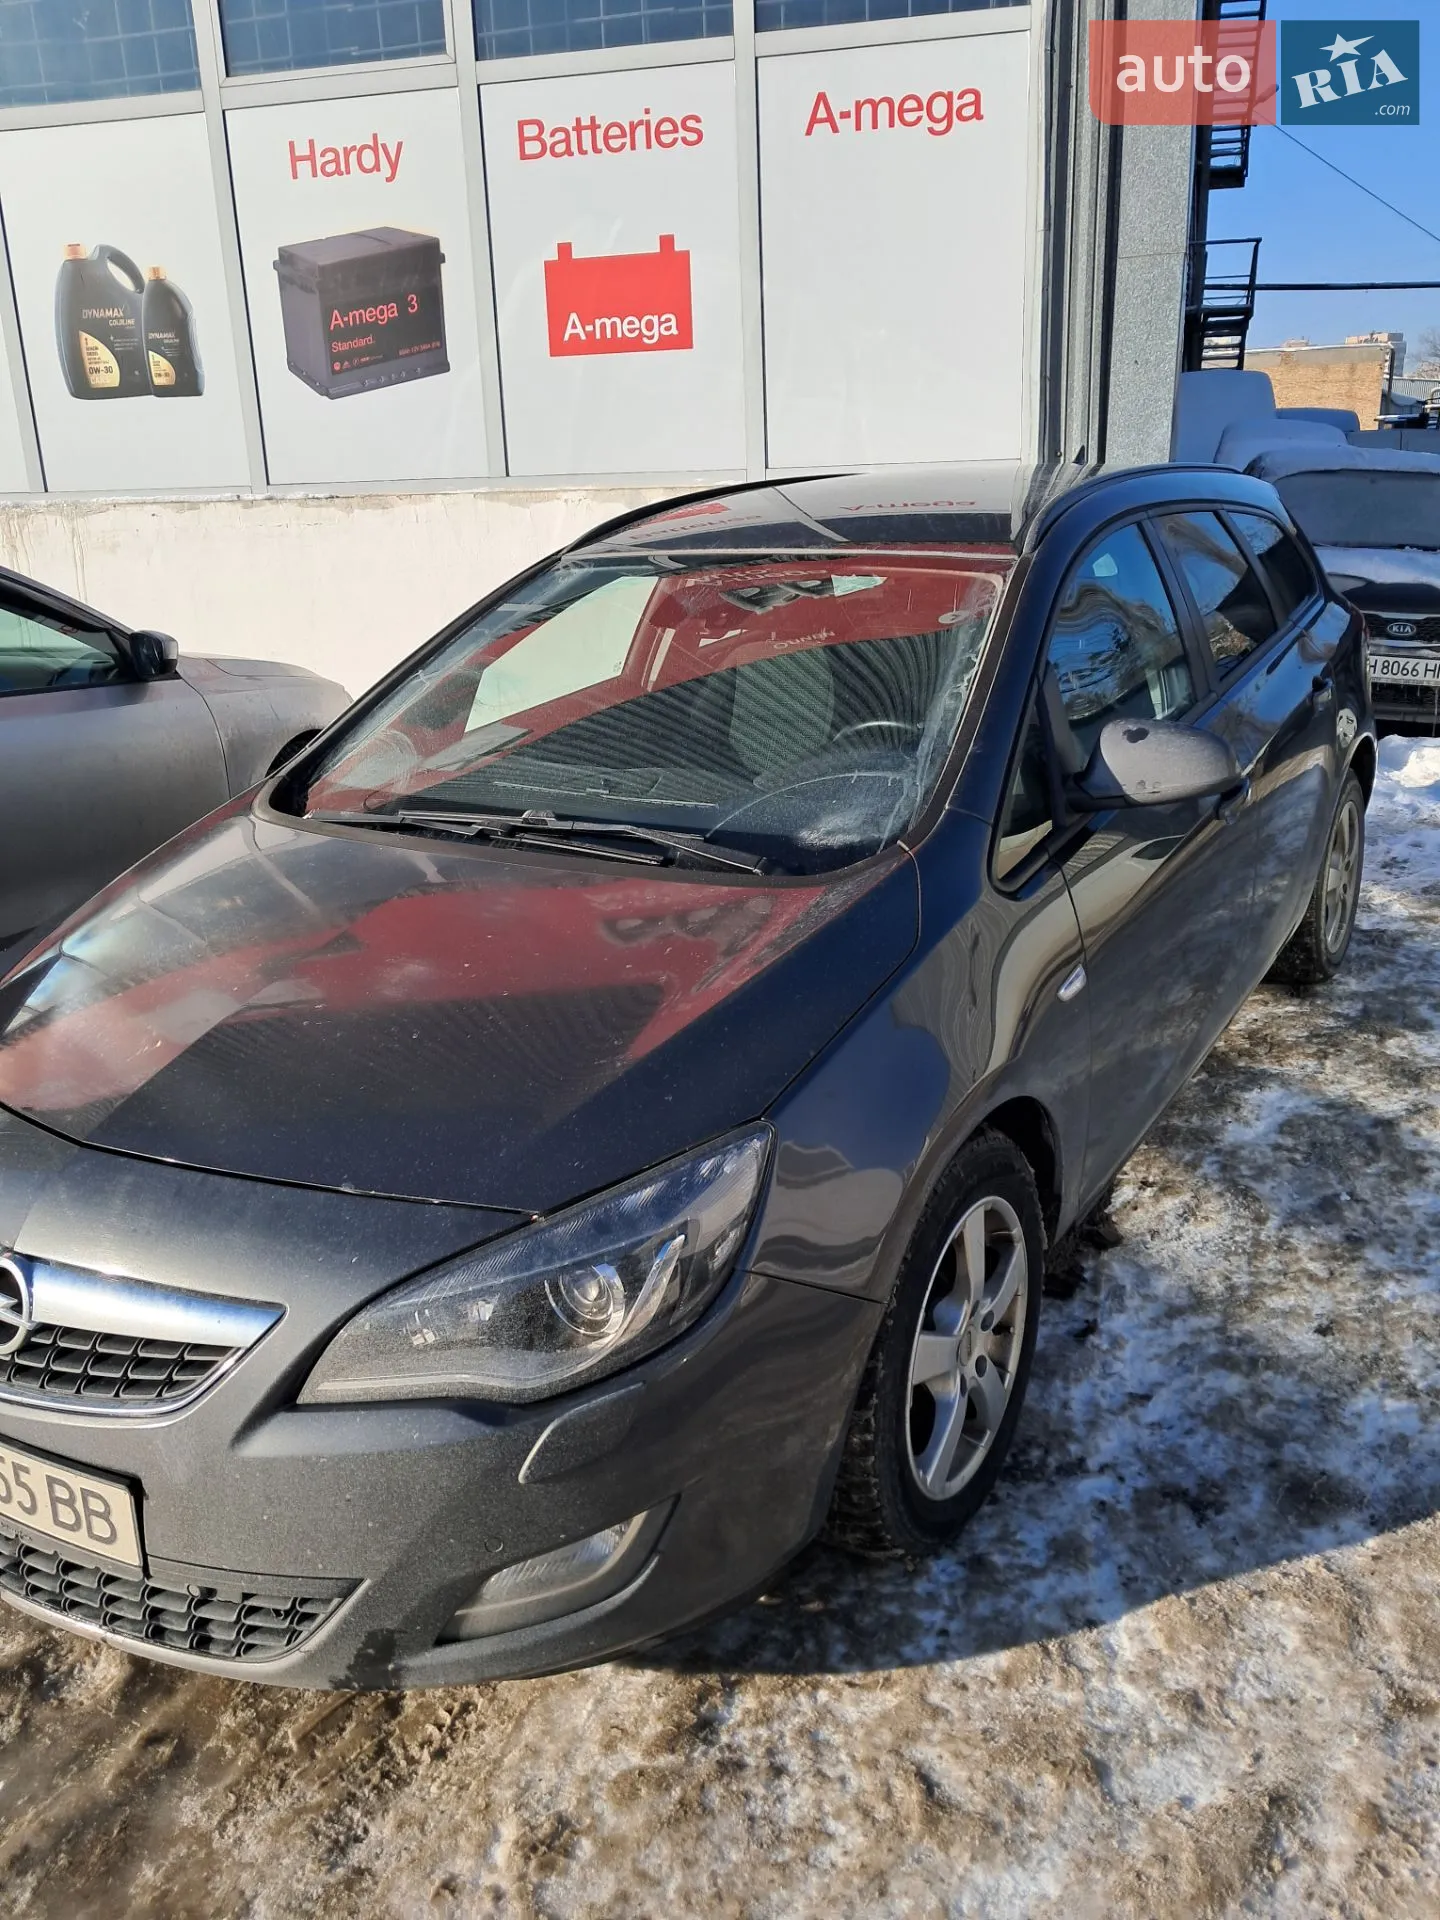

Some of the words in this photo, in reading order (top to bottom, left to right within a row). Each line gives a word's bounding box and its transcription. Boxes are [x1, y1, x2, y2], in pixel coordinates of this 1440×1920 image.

[804, 87, 984, 137] A-mega
[517, 108, 704, 161] Batteries
[288, 133, 403, 183] Hardy
[82, 306, 124, 319] DYNAMAX
[329, 301, 398, 331] A-mega
[407, 294, 419, 314] 3
[563, 311, 679, 344] A-mega
[1392, 625, 1412, 633] KIA
[1380, 659, 1420, 678] 8066
[1424, 663, 1440, 679] H
[45, 1474, 118, 1546] BB
